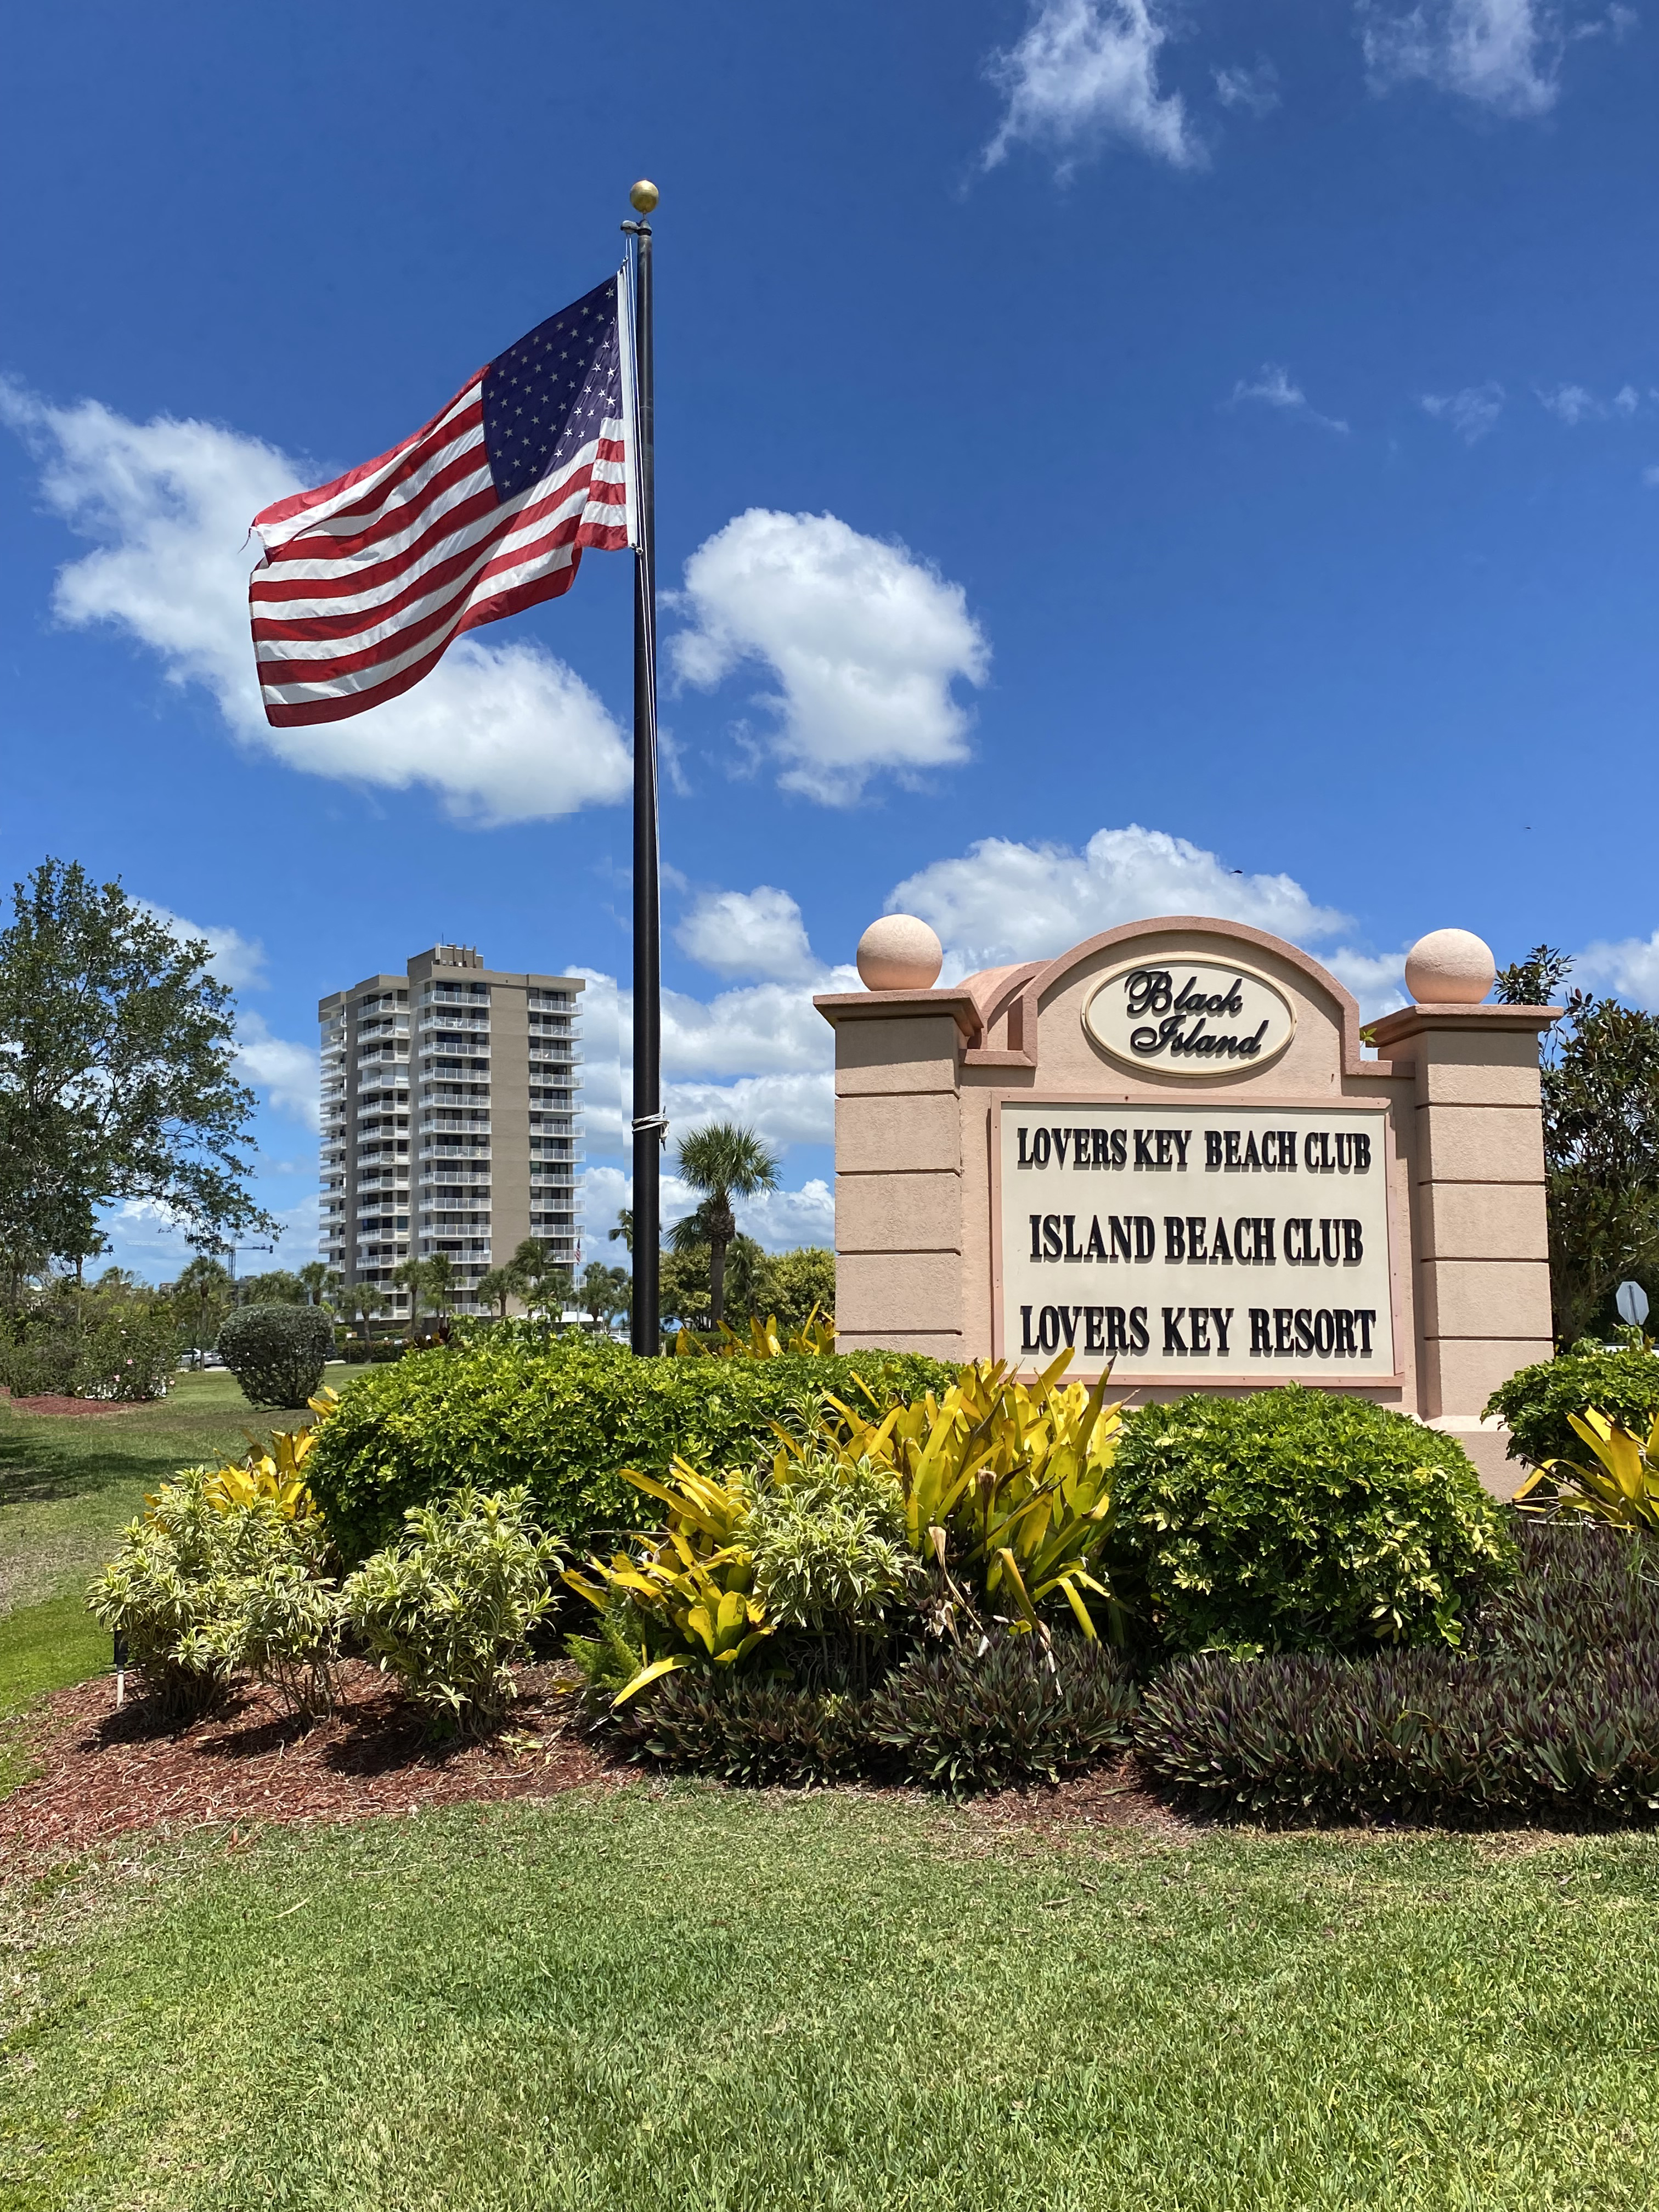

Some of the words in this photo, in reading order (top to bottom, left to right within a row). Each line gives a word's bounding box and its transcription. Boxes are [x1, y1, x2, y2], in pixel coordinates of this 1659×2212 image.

[1125, 970, 1243, 1014] Black
[1130, 1014, 1269, 1054] Island
[1017, 1127, 1127, 1165] LOVERS
[1133, 1129, 1192, 1166] KEY
[1204, 1130, 1297, 1167] BEACH
[1304, 1132, 1372, 1169] CLUB
[1029, 1215, 1155, 1259] ISLAND
[1164, 1216, 1277, 1261] BEACH
[1283, 1218, 1364, 1262] CLUB
[1020, 1305, 1150, 1351] LOVERS
[1161, 1307, 1234, 1352] KEY
[1249, 1308, 1377, 1353] RESORT
